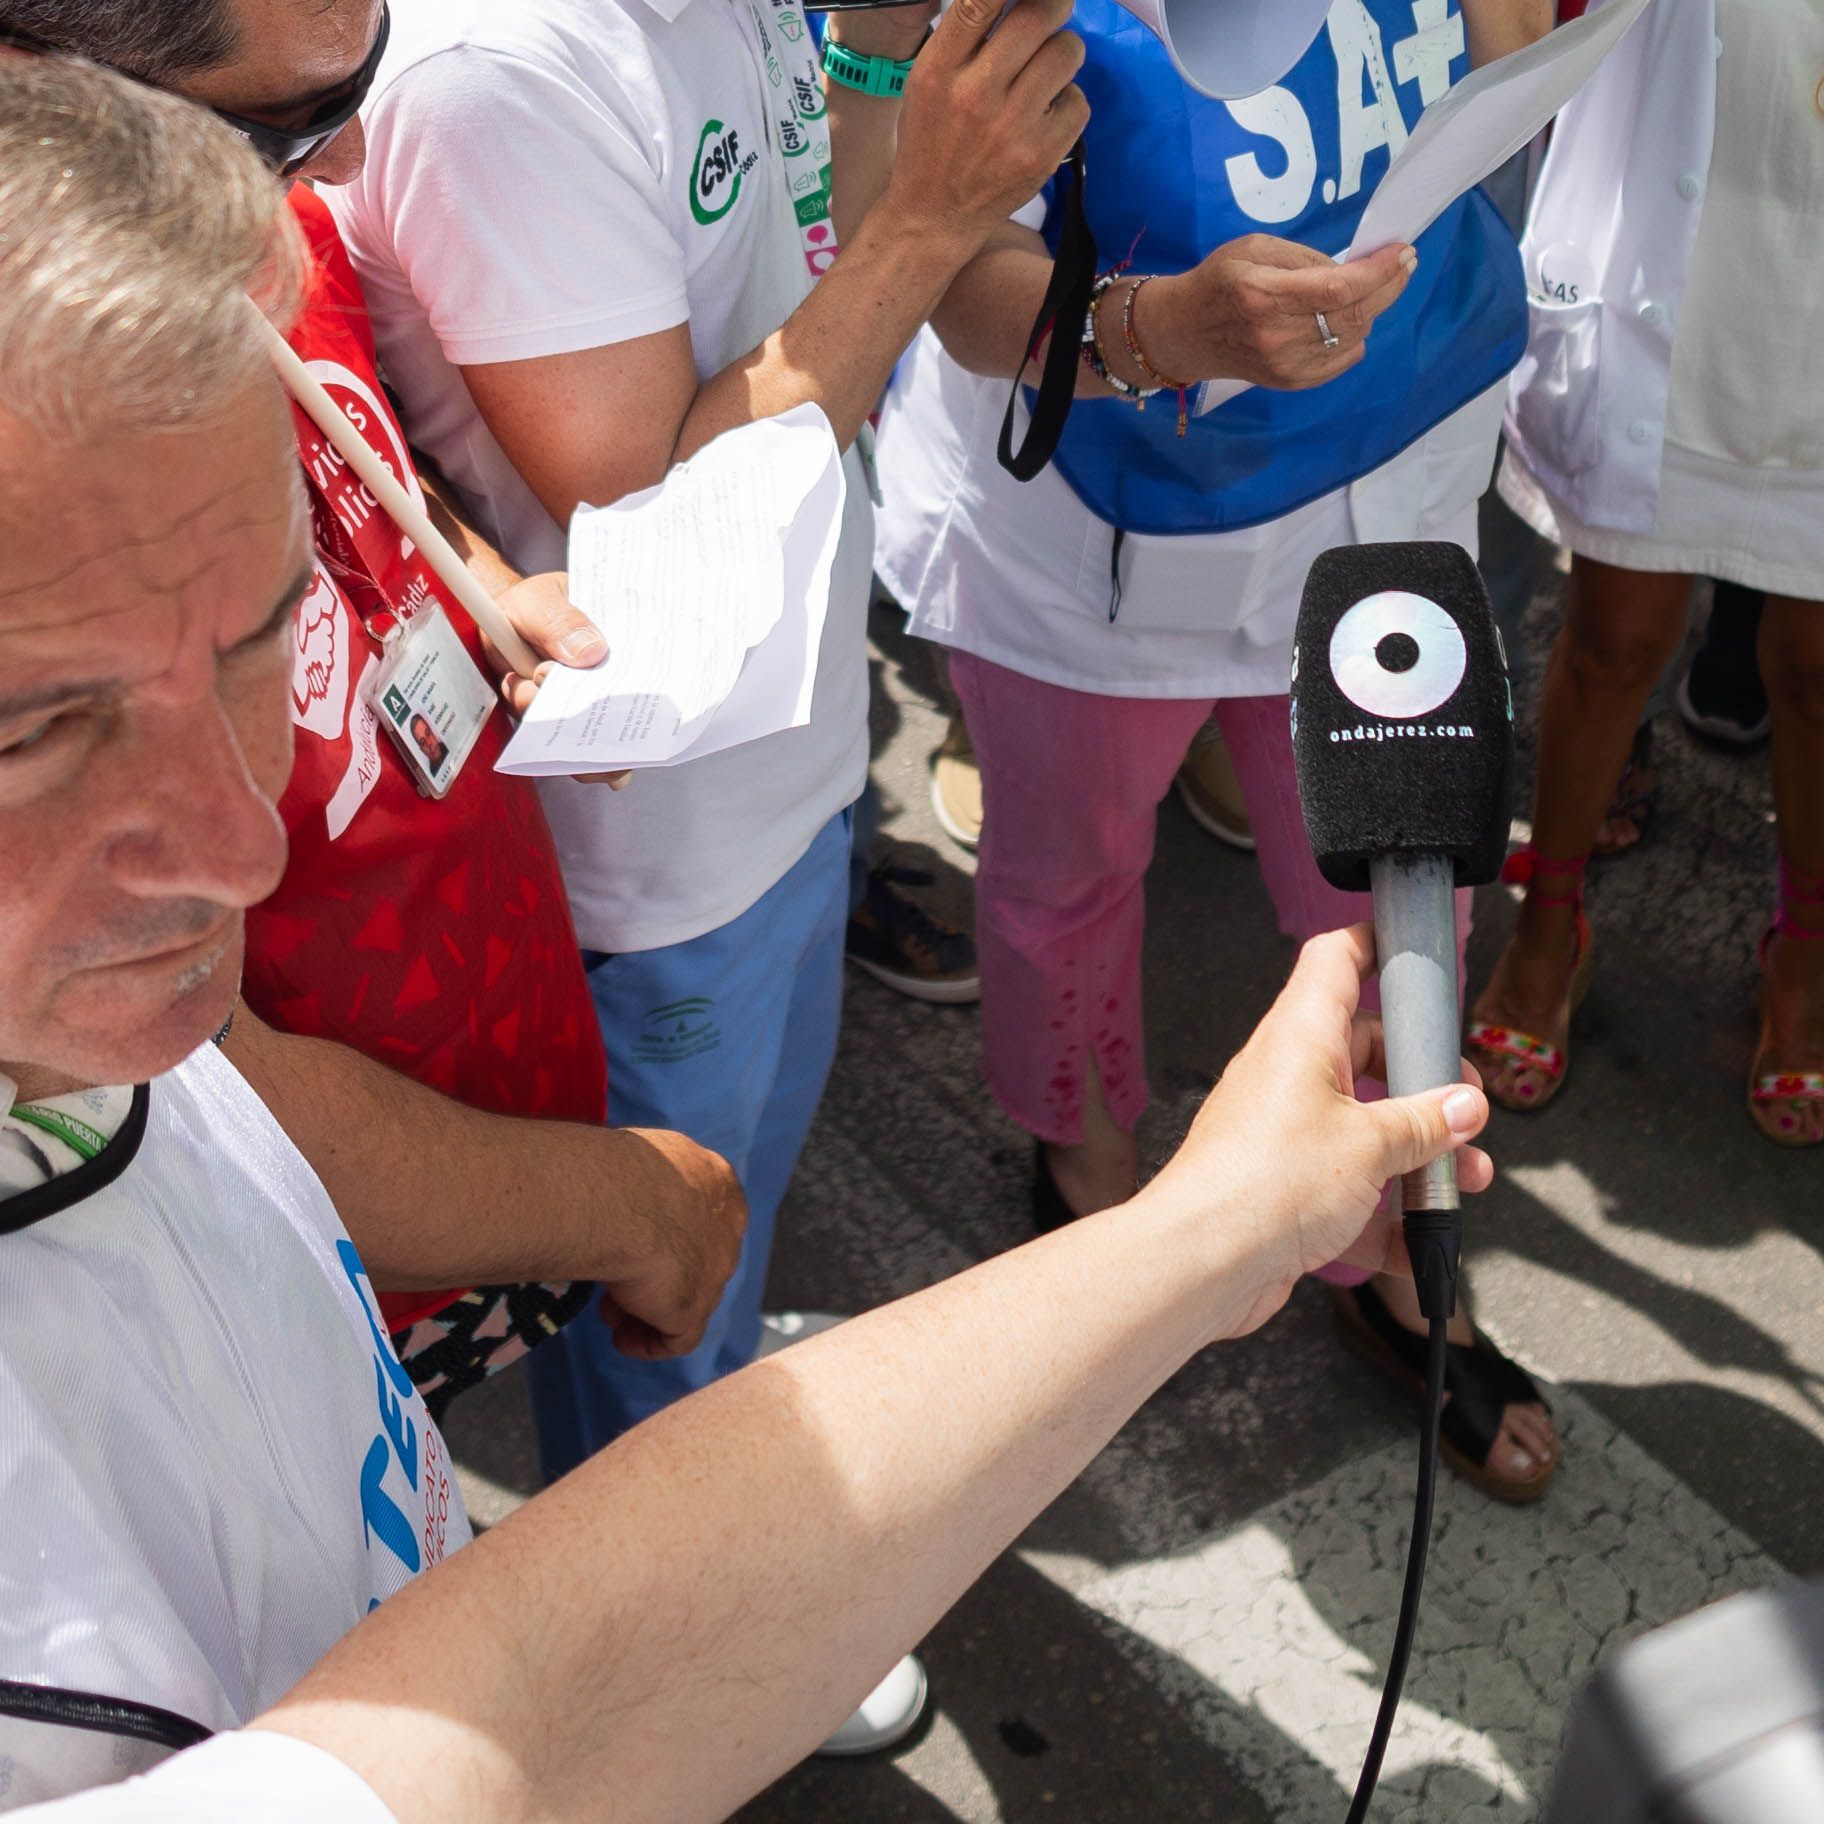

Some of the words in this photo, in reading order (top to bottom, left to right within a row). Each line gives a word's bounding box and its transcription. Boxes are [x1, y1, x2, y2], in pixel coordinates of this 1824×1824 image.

[794, 76, 816, 113] CSIF
[780, 120, 800, 151] CSIF
[700, 130, 740, 198] CSIF
[1330, 722, 1475, 743] ondajerez.com
